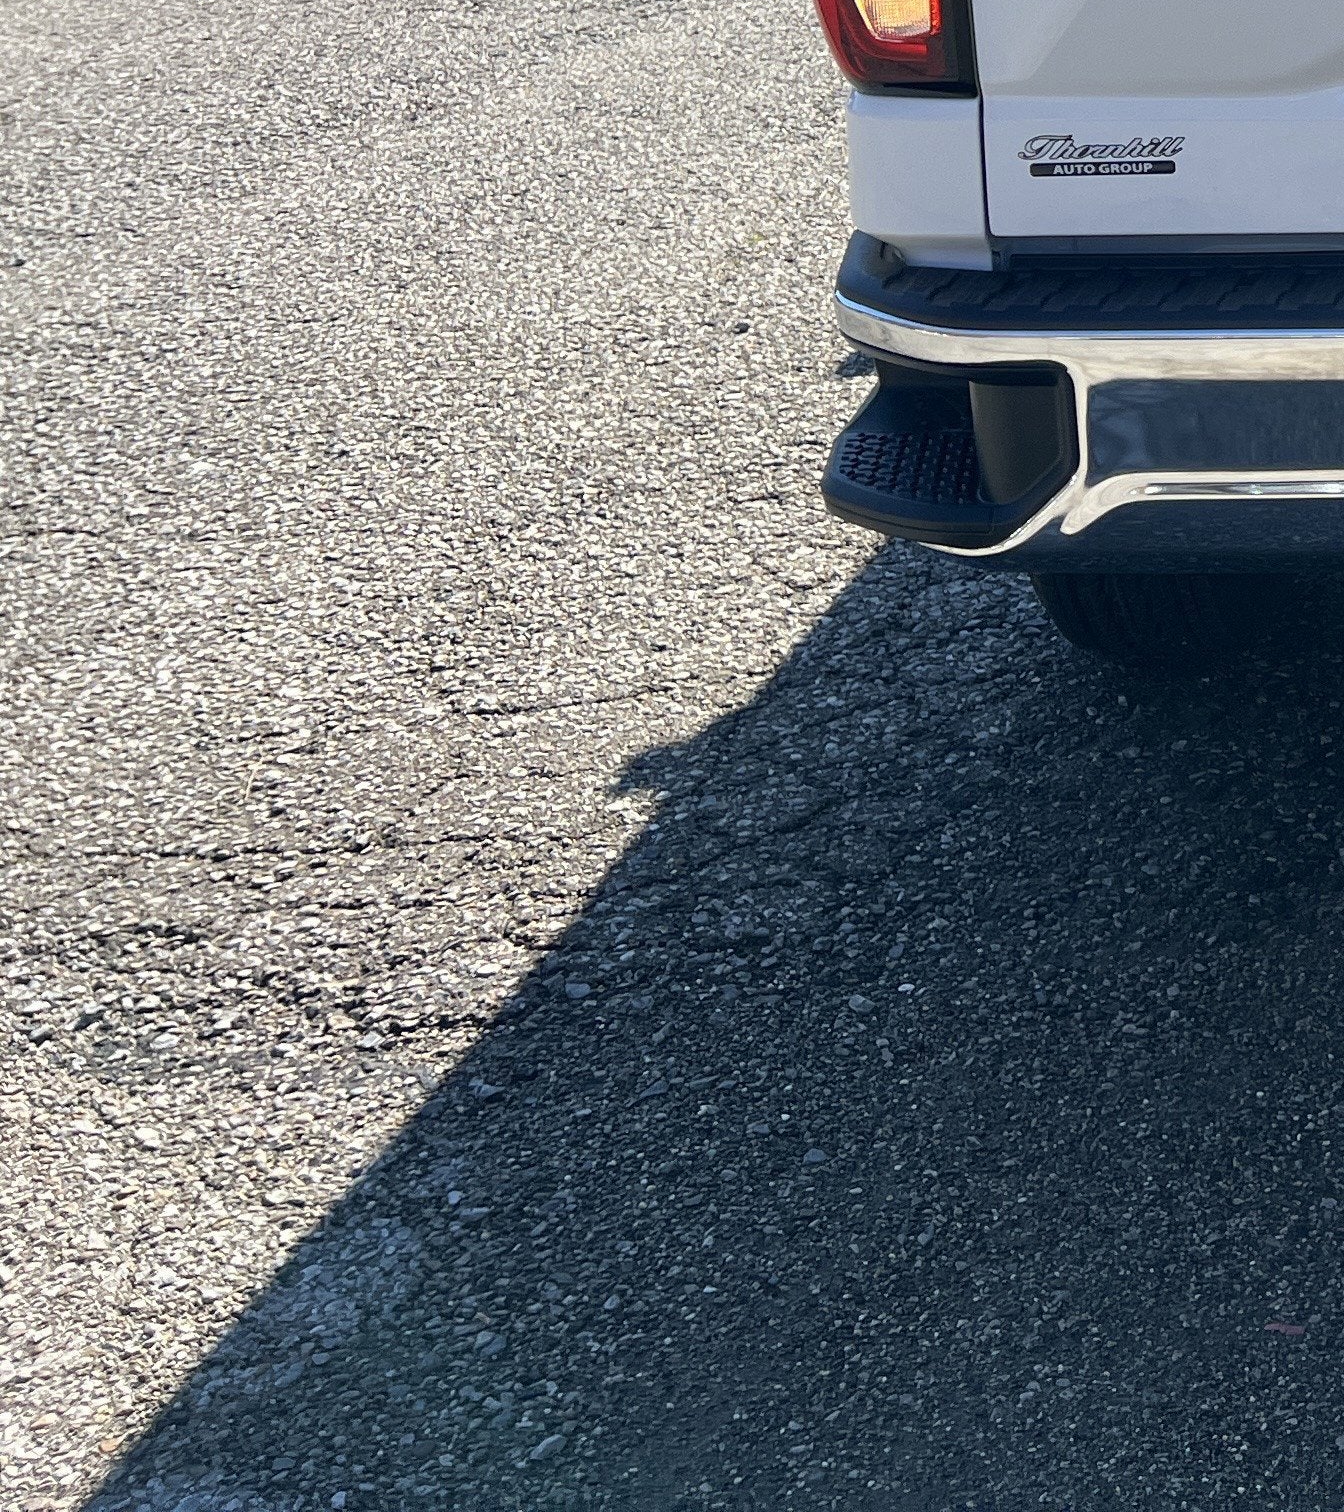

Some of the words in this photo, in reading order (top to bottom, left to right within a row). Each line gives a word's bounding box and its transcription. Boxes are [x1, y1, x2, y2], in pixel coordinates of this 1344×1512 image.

[1017, 134, 1186, 161] Thornhill
[1053, 164, 1096, 175] AUTO
[1098, 162, 1153, 174] GROUP
